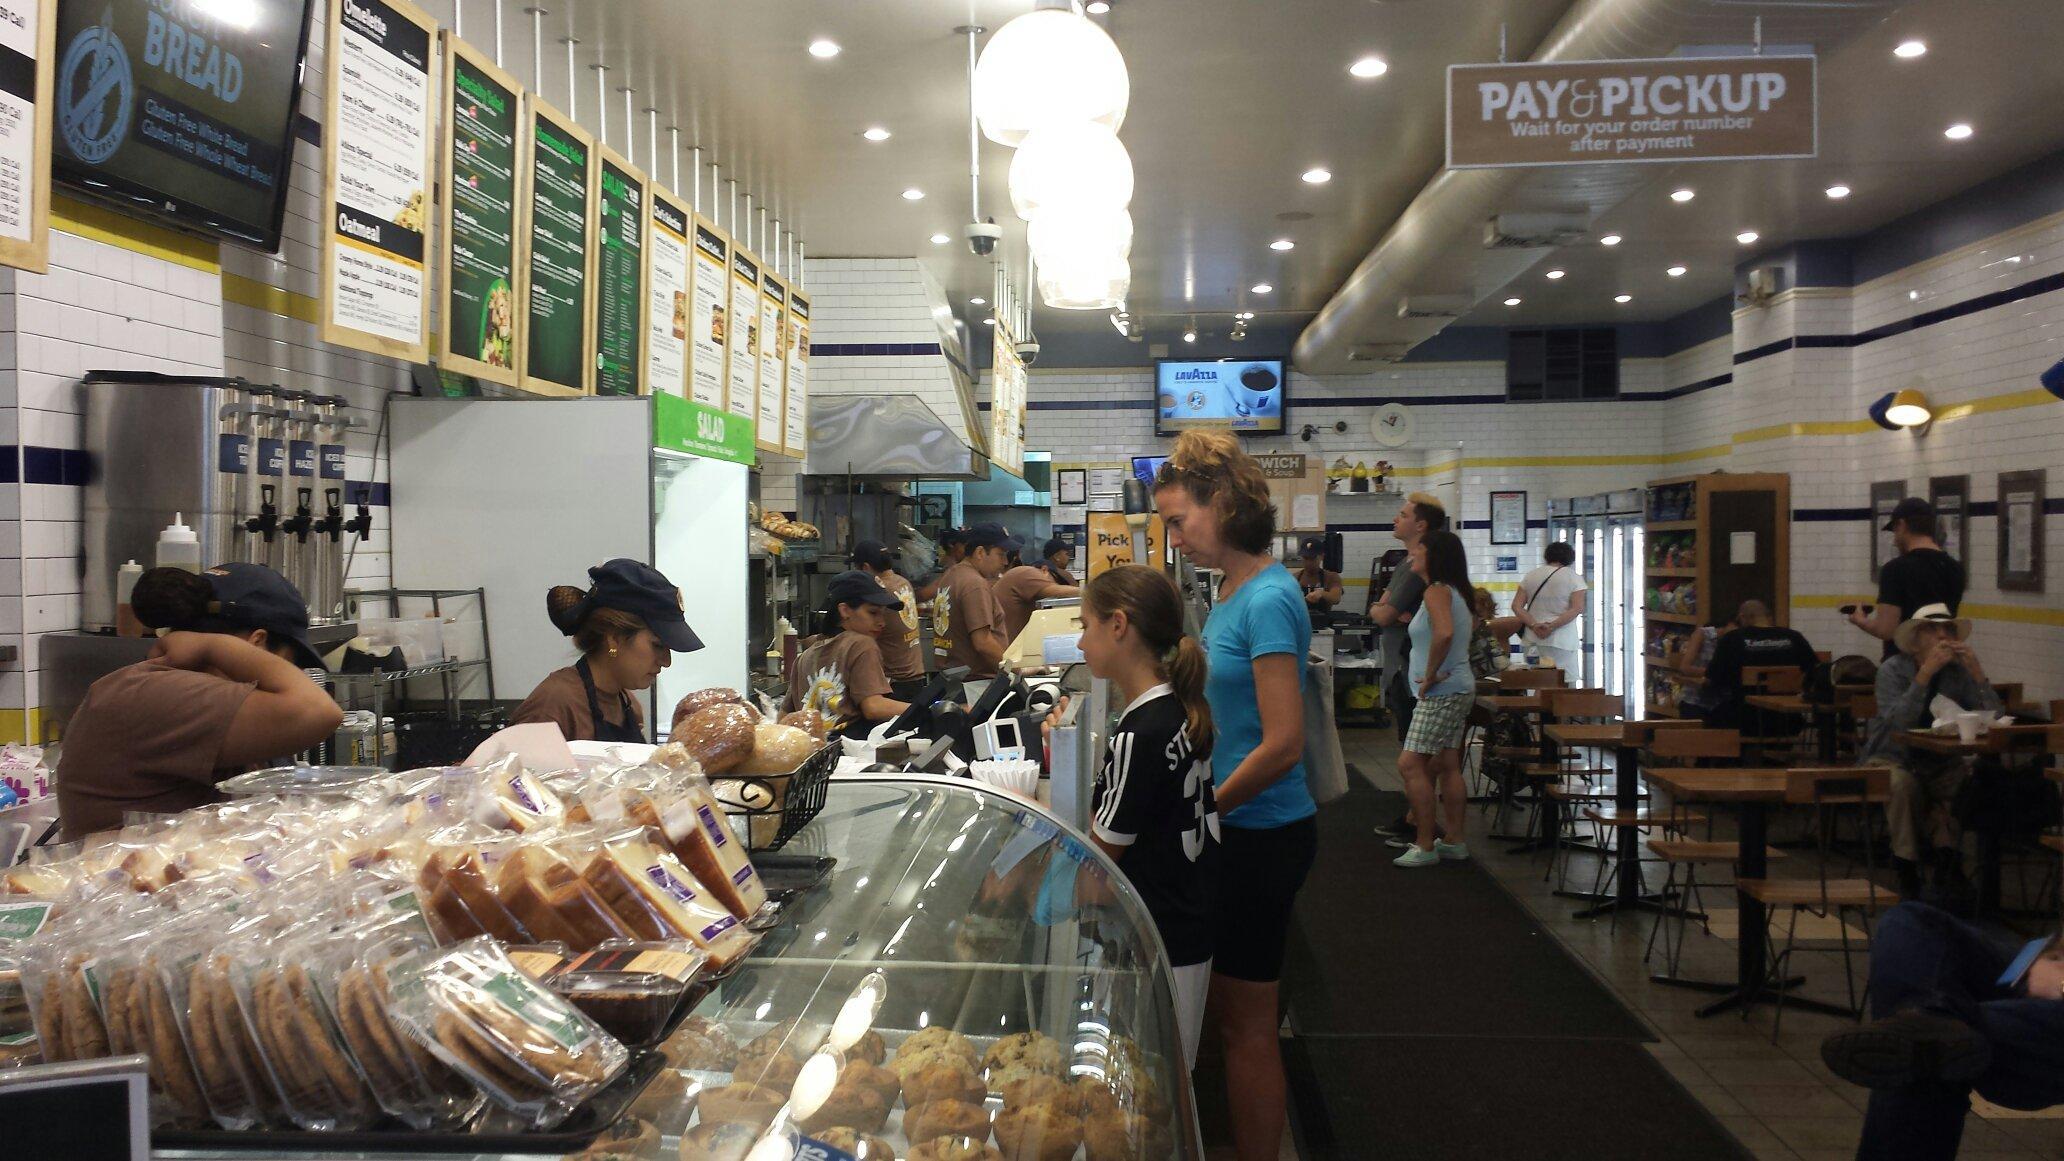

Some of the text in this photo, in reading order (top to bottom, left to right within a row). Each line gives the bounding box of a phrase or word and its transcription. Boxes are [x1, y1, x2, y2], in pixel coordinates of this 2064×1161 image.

[144, 10, 243, 104] BREAD
[145, 98, 249, 157] Gluten Free White Bread
[1511, 115, 1754, 140] Wait for your order number
[142, 118, 273, 187] Gluten Free Whole Wheat Bread
[1569, 135, 1694, 153] after payment
[339, 212, 381, 243] Oatmeal
[1175, 368, 1218, 380] LAVAZZA
[697, 411, 725, 443] SALAD
[1259, 457, 1300, 469] WICH
[1273, 468, 1295, 478] Soup
[1097, 533, 1129, 547] Pick
